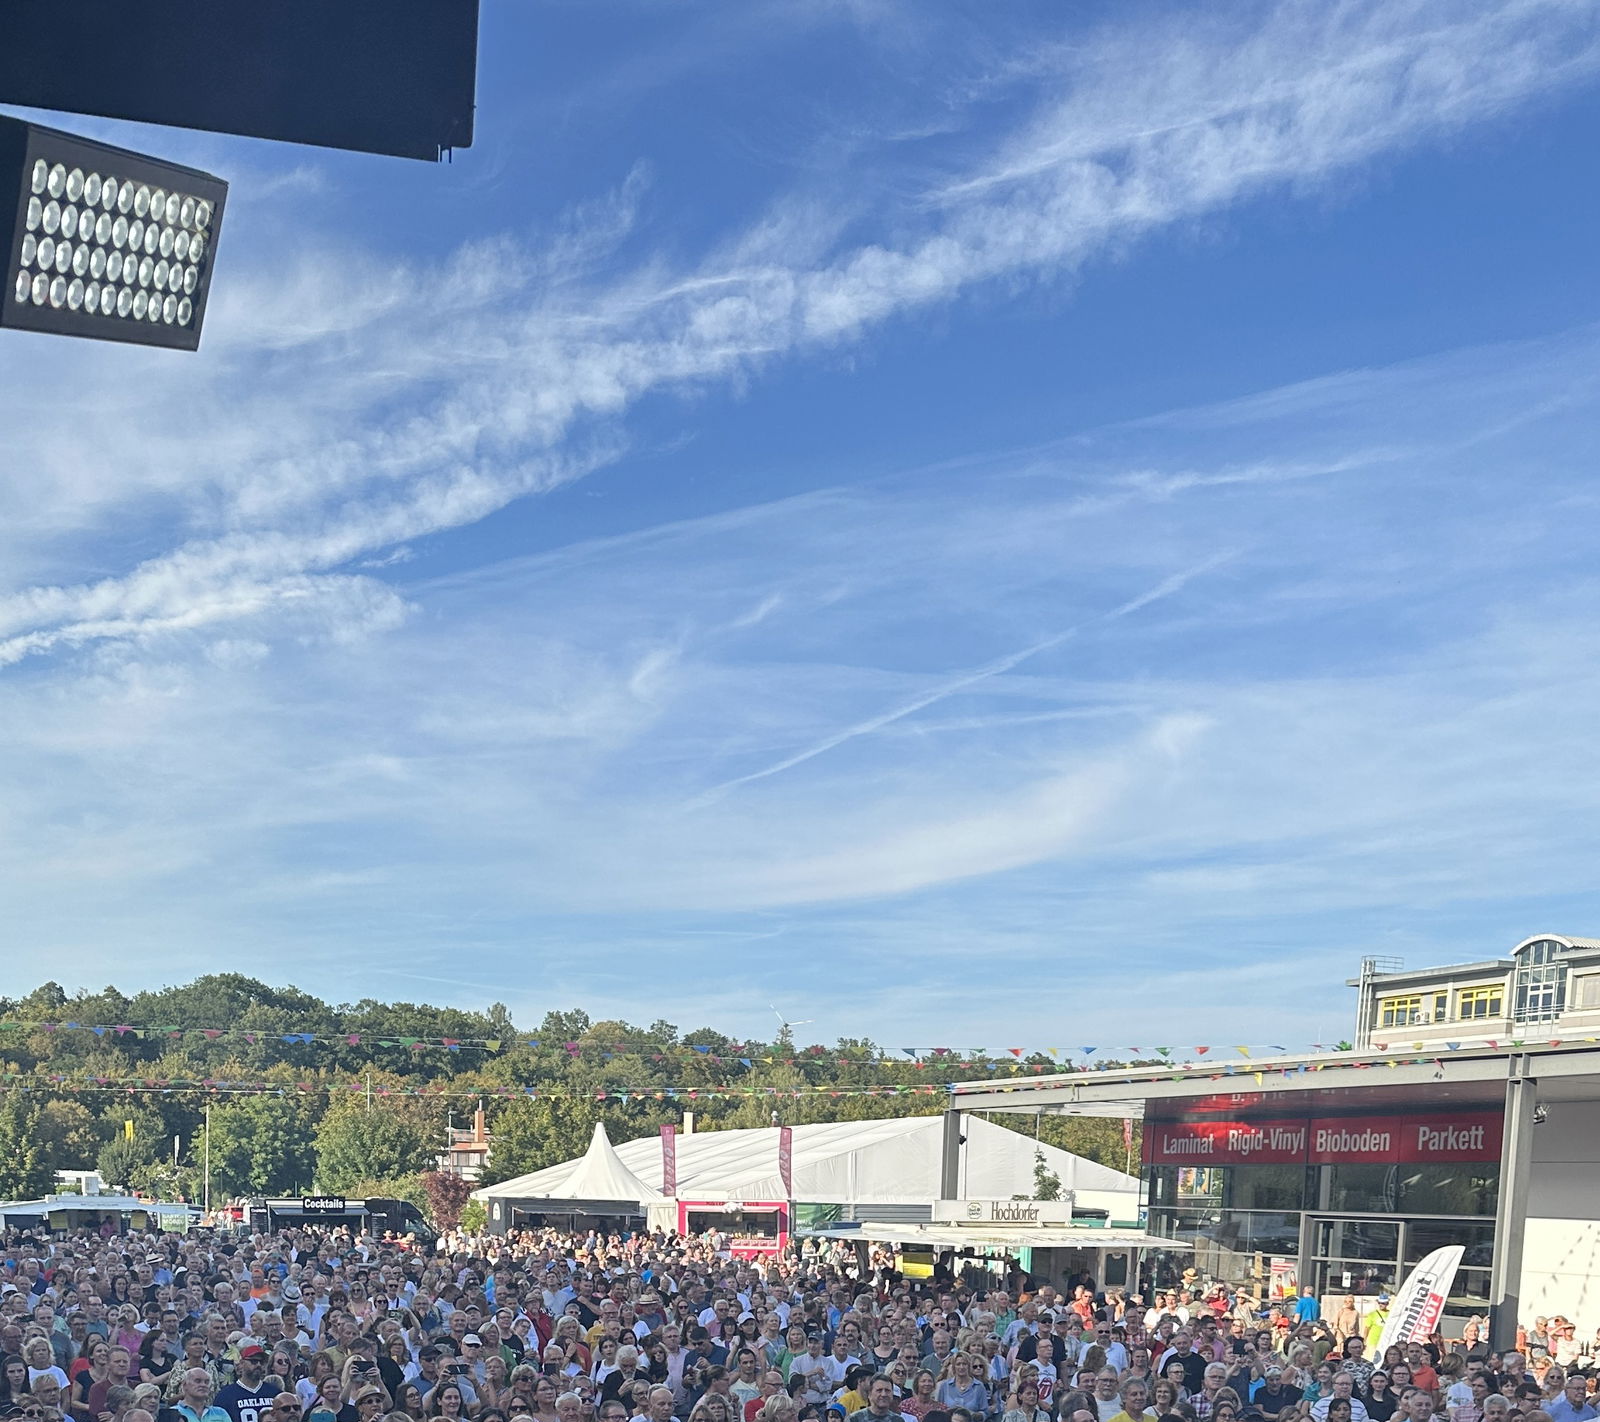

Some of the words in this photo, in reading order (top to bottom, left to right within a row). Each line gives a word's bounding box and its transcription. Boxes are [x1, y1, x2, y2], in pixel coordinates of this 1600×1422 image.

[1163, 1133, 1214, 1154] Laminat
[1228, 1127, 1305, 1155] Rigid-Vinyl
[1316, 1128, 1390, 1152] Bioboden
[1418, 1125, 1484, 1151] Parkett
[304, 1198, 344, 1209] Cocktails
[991, 1201, 1040, 1221] Hochdorfer
[1396, 1277, 1432, 1342] aminat
